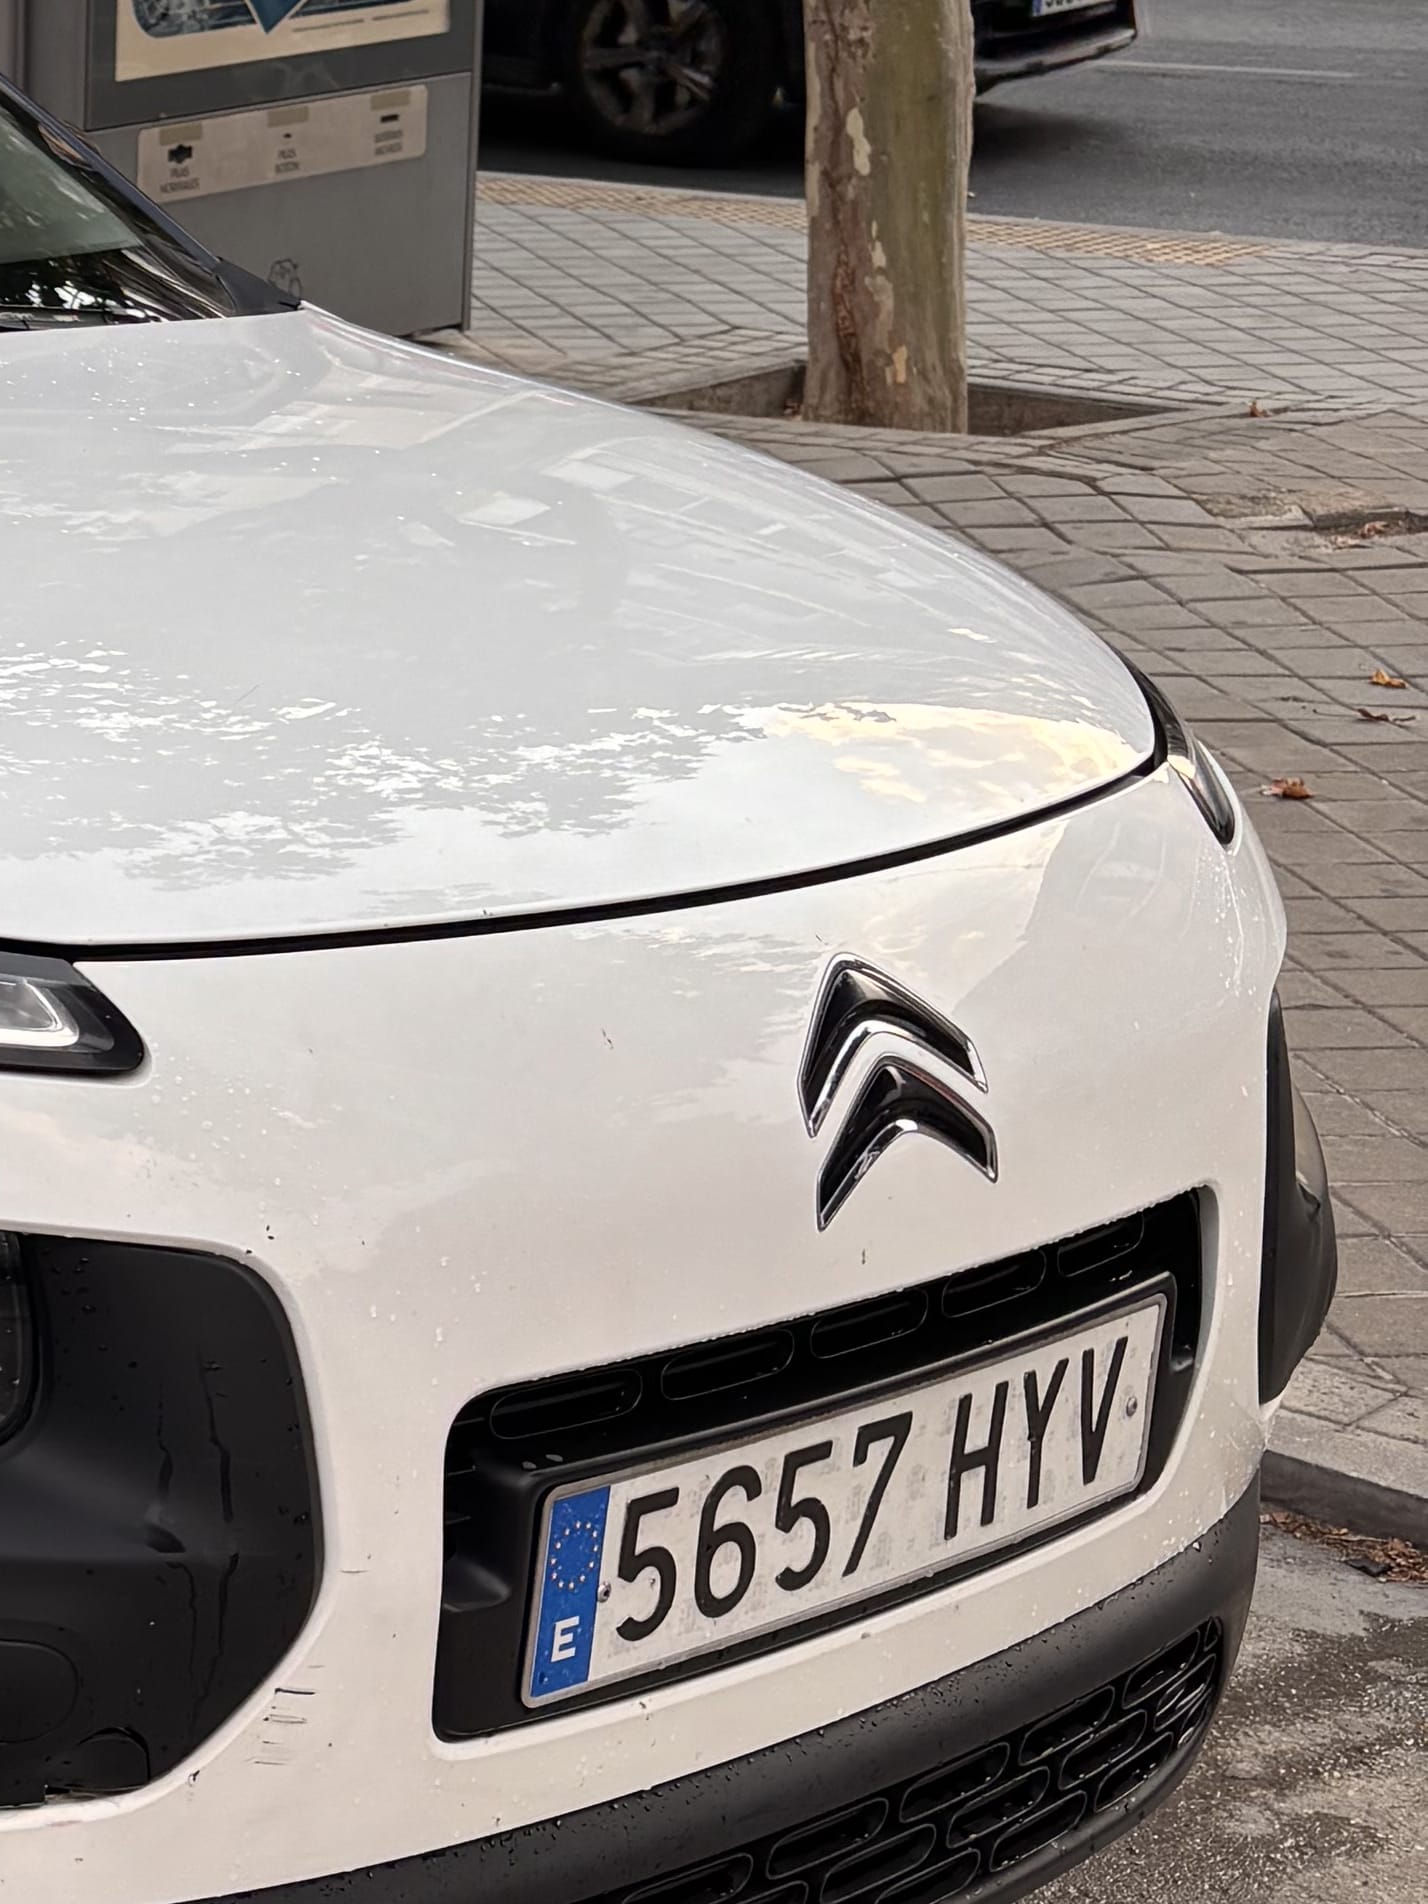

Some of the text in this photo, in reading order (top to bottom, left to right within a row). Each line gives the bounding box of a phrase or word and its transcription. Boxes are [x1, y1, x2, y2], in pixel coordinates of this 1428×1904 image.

[550, 1334, 1130, 1663] E 5657 HYV
